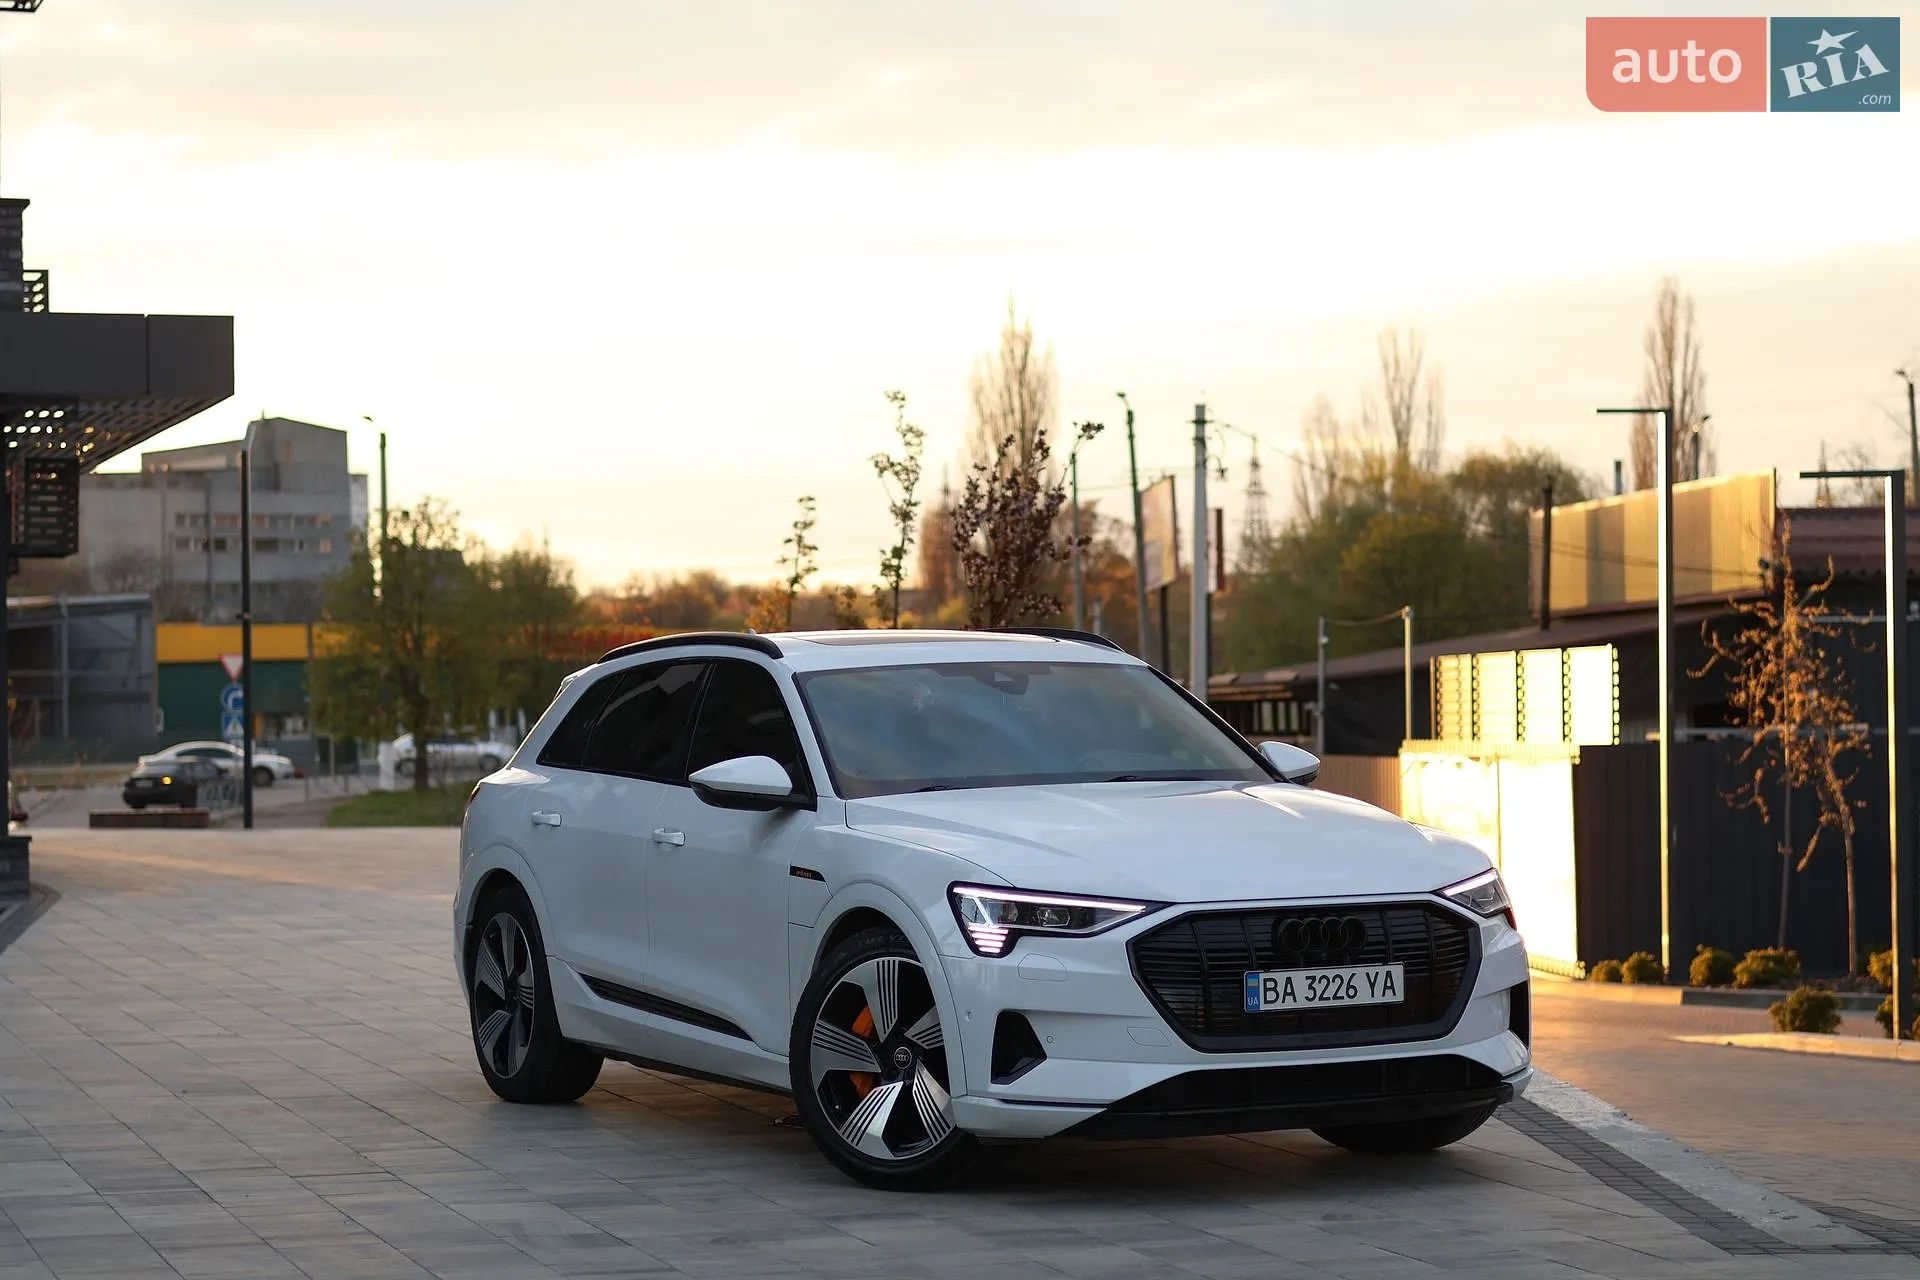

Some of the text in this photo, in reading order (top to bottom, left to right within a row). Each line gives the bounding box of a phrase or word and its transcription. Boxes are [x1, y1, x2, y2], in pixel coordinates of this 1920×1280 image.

[1262, 970, 1397, 1005] BA 3226 YA
[1247, 997, 1259, 1006] UA
